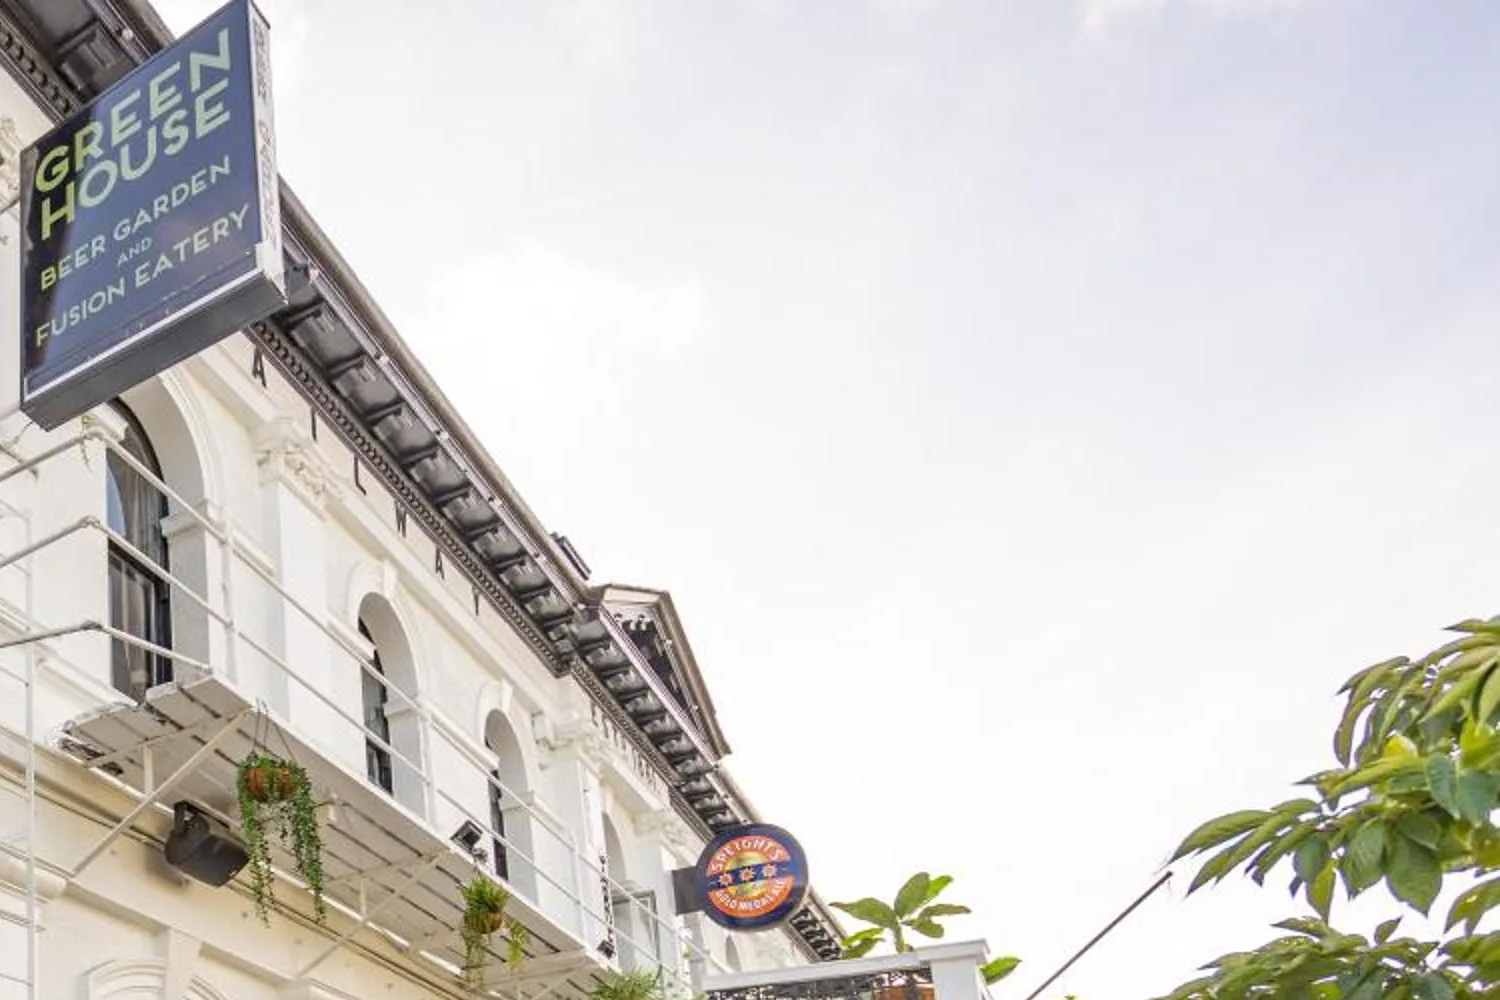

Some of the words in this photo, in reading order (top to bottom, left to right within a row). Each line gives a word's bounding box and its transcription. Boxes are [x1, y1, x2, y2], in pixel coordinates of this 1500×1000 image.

[35, 28, 231, 193] GREEN
[41, 77, 230, 241] HOUSE
[35, 278, 125, 347] FUSION
[135, 204, 249, 289] EATERY
[41, 235, 106, 291] BEER
[114, 155, 231, 242] GARDEN
[116, 237, 152, 268] AND
